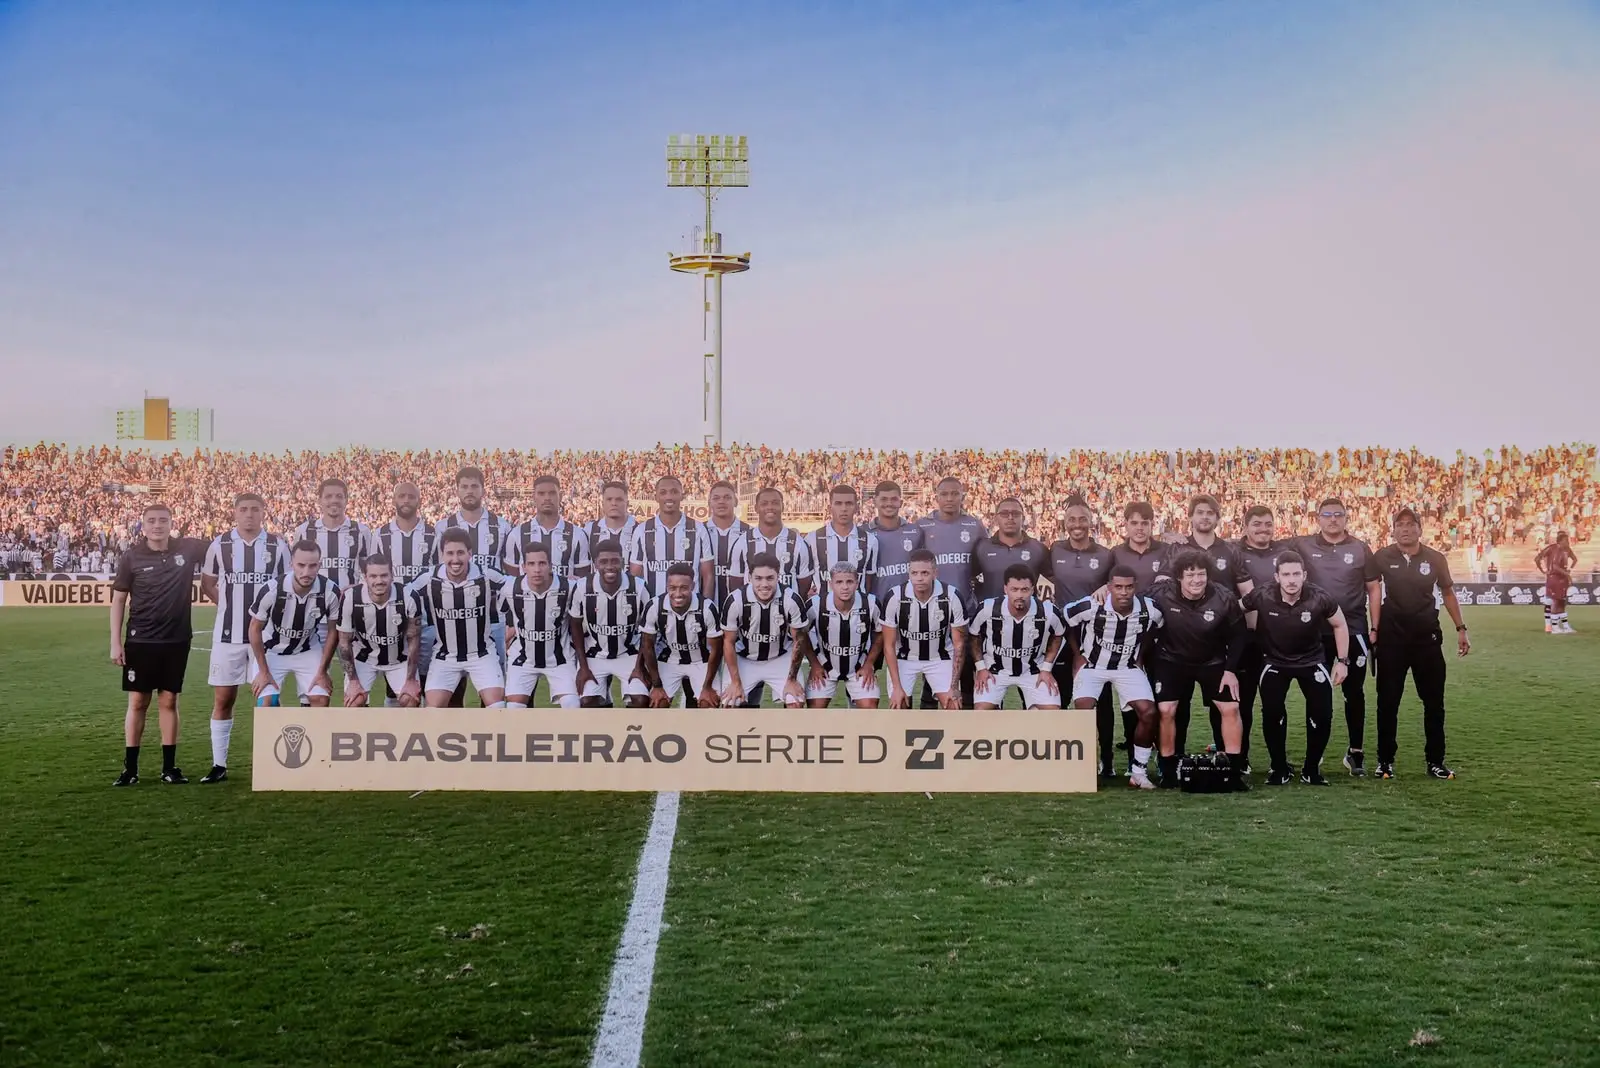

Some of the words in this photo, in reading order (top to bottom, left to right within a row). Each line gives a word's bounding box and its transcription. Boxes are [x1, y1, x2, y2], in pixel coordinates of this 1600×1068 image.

[935, 552, 971, 565] IDEBET
[435, 606, 485, 620] VAIDEBET
[589, 624, 635, 636] VAIDEBET
[900, 628, 946, 641] VAIDEBET
[993, 645, 1040, 659] VAIDEBET
[331, 725, 686, 763] BRASILEIRÃO
[705, 727, 844, 763] SÉRIE
[858, 735, 887, 763] D
[953, 738, 1084, 761] zeroum
